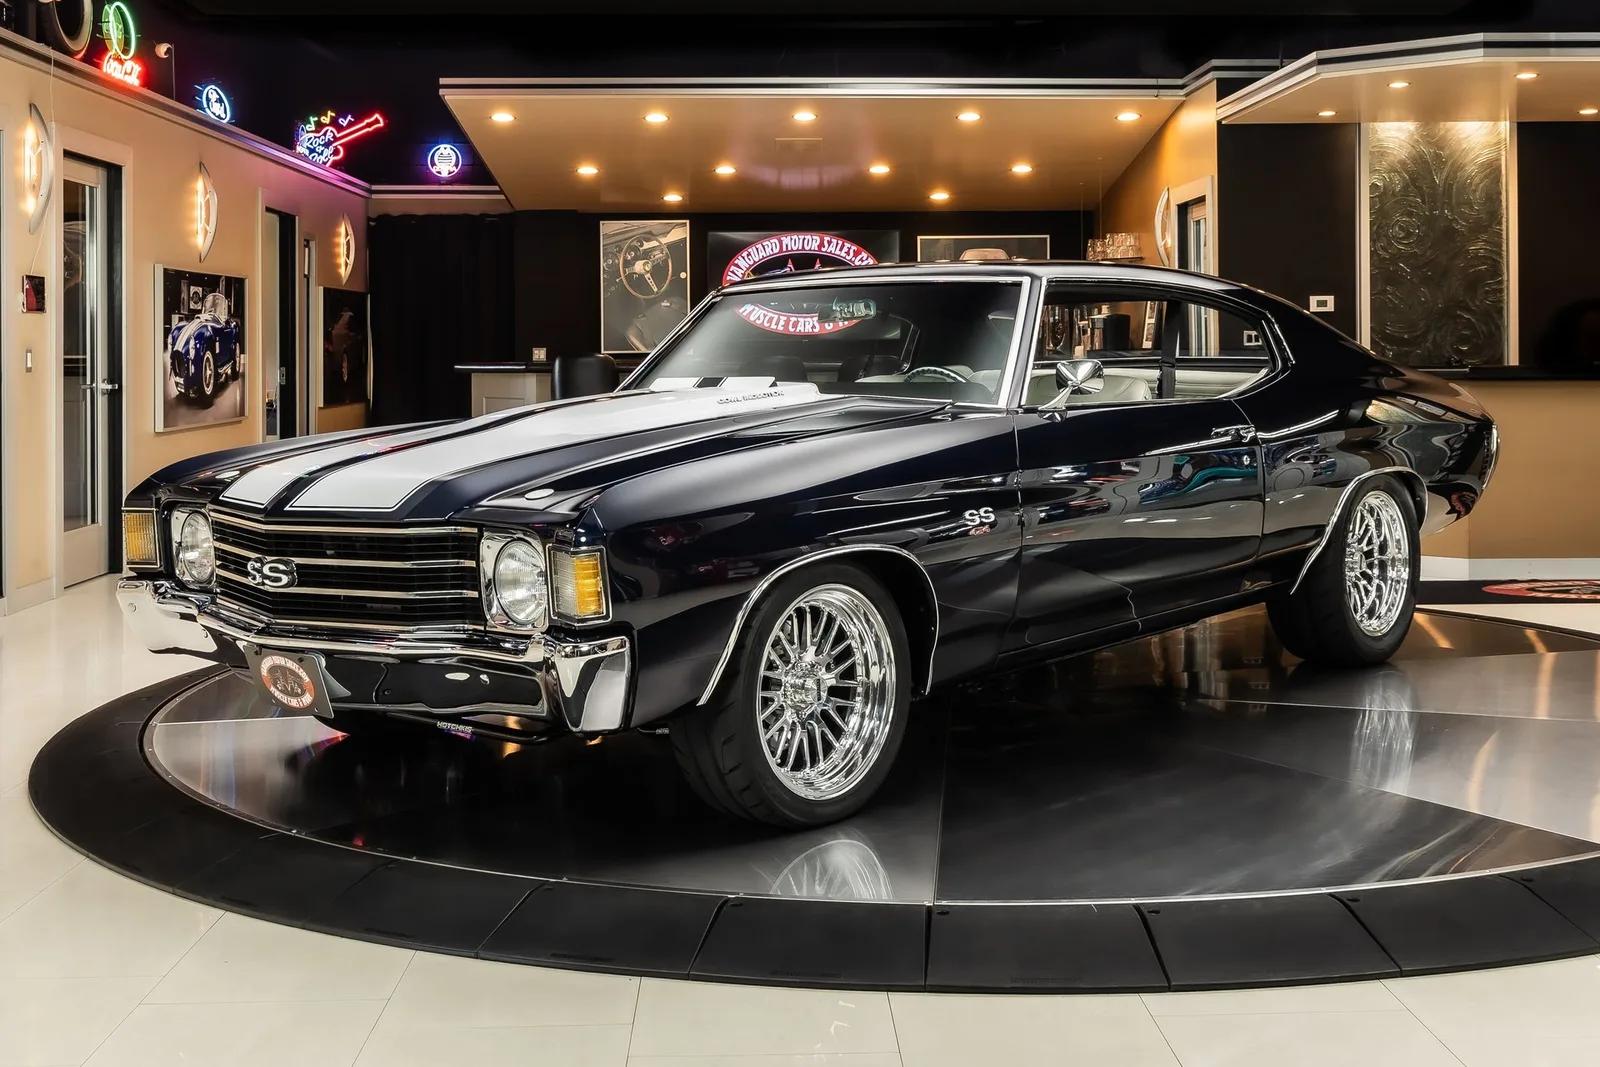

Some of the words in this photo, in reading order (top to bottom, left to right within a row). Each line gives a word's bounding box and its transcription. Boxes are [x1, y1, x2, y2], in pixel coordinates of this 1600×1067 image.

[305, 129, 334, 149] Rock
[726, 239, 780, 281] VANGUARD
[781, 235, 820, 251] MOTOR
[739, 303, 788, 331] MUSCLE
[788, 316, 820, 333] CARS
[963, 506, 996, 526] SS
[247, 560, 292, 587] SS
[436, 721, 473, 733] HOTCHKIS
